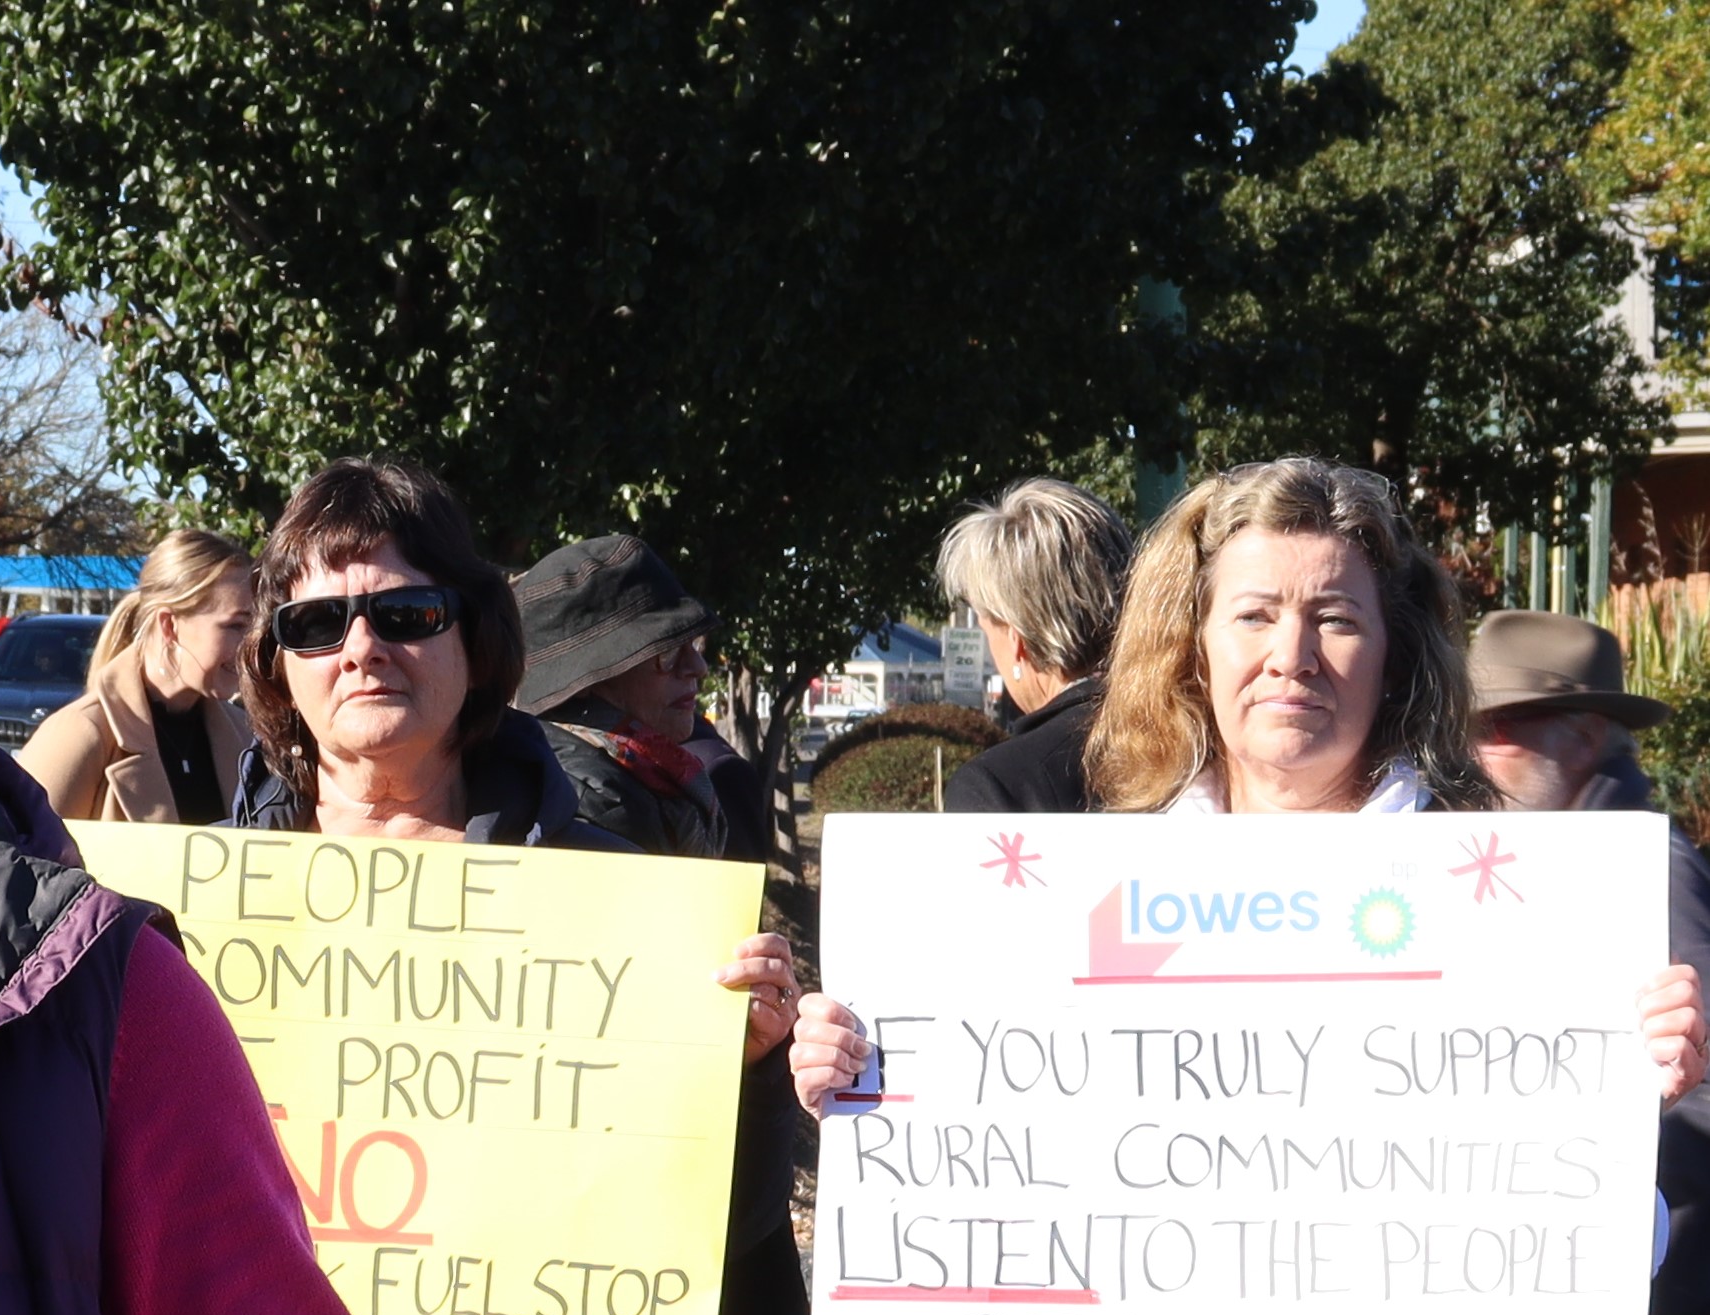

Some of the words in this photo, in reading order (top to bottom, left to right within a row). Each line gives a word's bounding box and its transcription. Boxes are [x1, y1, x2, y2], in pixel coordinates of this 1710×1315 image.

[180, 831, 526, 934] PEOPLE
[1130, 879, 1321, 935] lowes
[182, 930, 632, 1038] OMMUNITY
[961, 1019, 1089, 1105] YOU
[1110, 1024, 1326, 1108] TRULY
[1363, 1024, 1632, 1098] SUPPORT
[268, 1106, 428, 1233] NO
[853, 1115, 1070, 1189] RURAL
[1114, 1122, 1601, 1200] COMMUNITIES
[1093, 1213, 1196, 1303] TO
[1212, 1219, 1351, 1301] THE
[1378, 1220, 1611, 1301] PEOPLE
